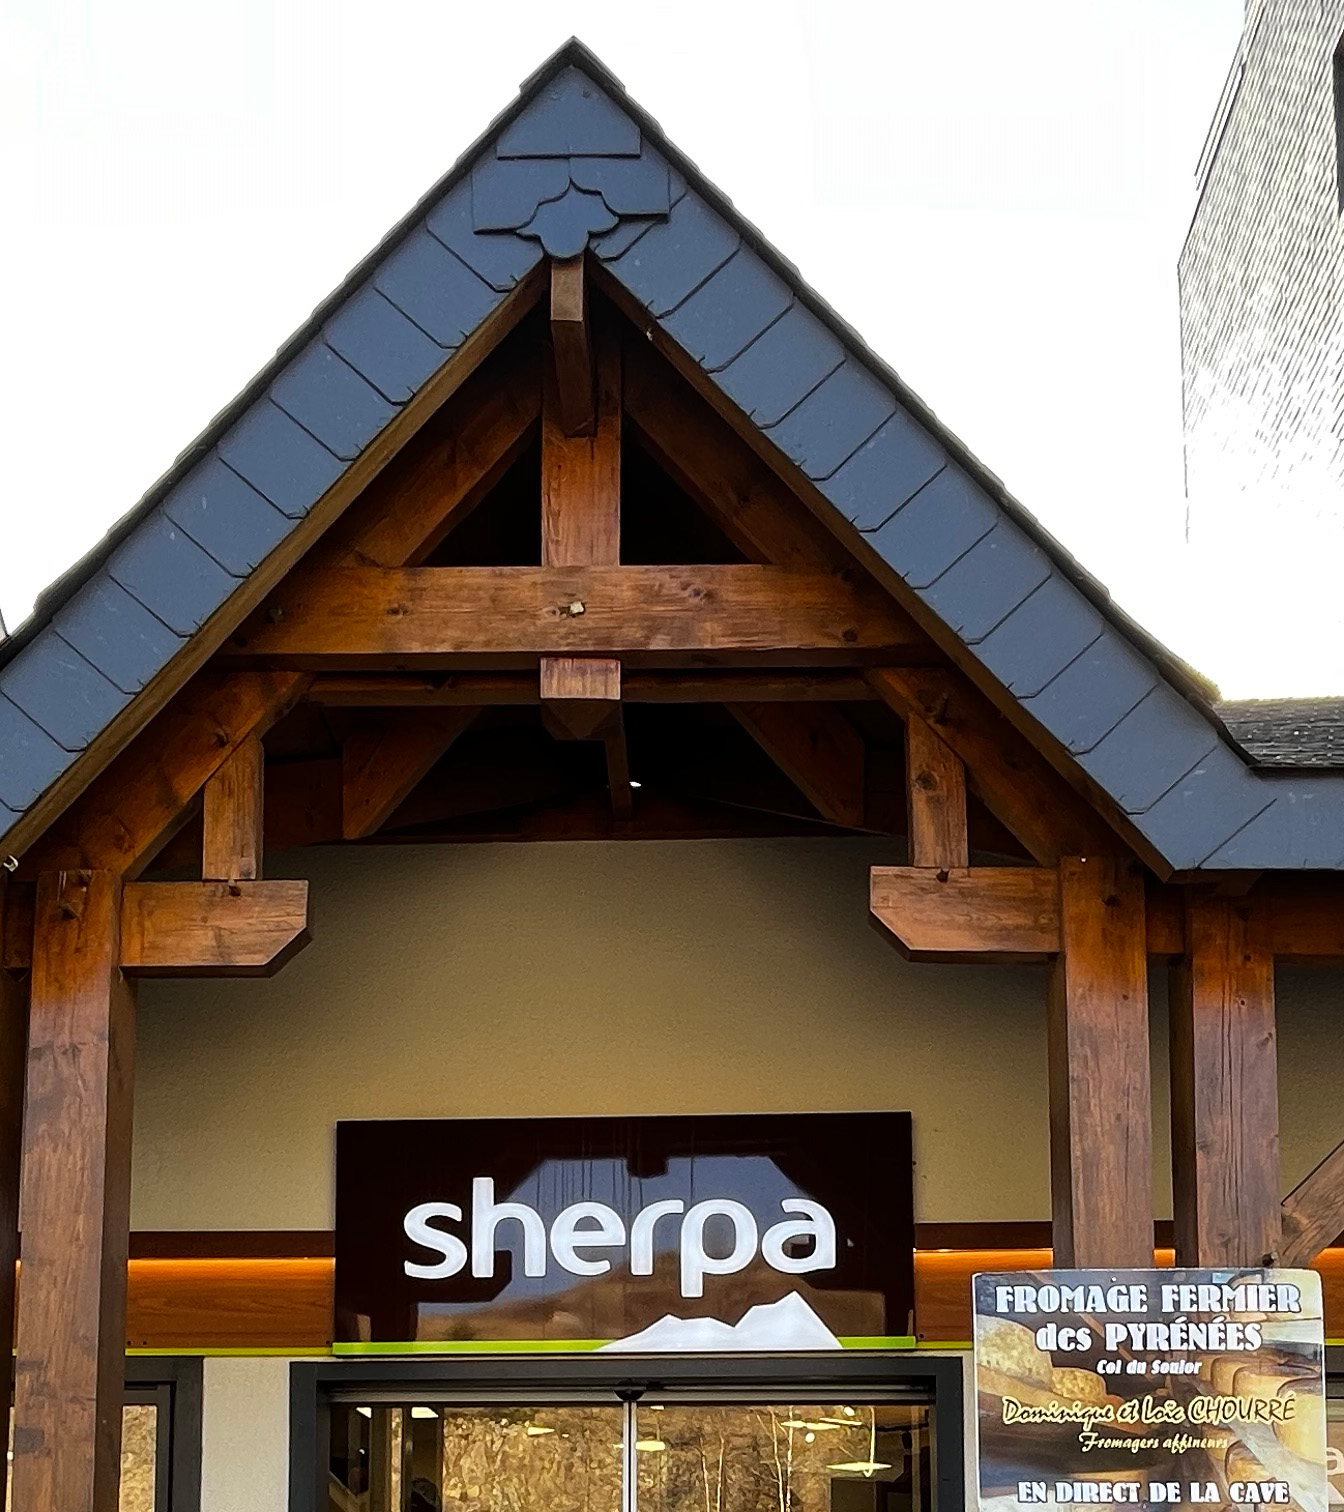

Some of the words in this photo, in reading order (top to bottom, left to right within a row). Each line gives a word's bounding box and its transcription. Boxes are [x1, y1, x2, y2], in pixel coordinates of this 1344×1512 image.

[403, 1177, 837, 1299] sherpa
[994, 1283, 1149, 1314] FROMAGE
[1160, 1283, 1302, 1314] FERMIER
[1035, 1321, 1093, 1352] des
[1105, 1315, 1263, 1352] PYRÉNÉES
[1096, 1358, 1122, 1375] Col
[1128, 1358, 1146, 1375] du
[1151, 1358, 1203, 1375] Soulor
[1002, 1395, 1114, 1432] Dominique
[1116, 1395, 1140, 1424] et
[1143, 1395, 1186, 1424] Loïc
[1187, 1393, 1296, 1424] CHOURRÉ
[1078, 1431, 1159, 1453] Fromagers
[1162, 1432, 1228, 1453] affineurs
[1017, 1481, 1047, 1504] EN
[1055, 1481, 1141, 1504] DIRECT
[1149, 1481, 1181, 1504] DE
[1190, 1481, 1220, 1504] LA
[1229, 1481, 1290, 1504] CAVE
